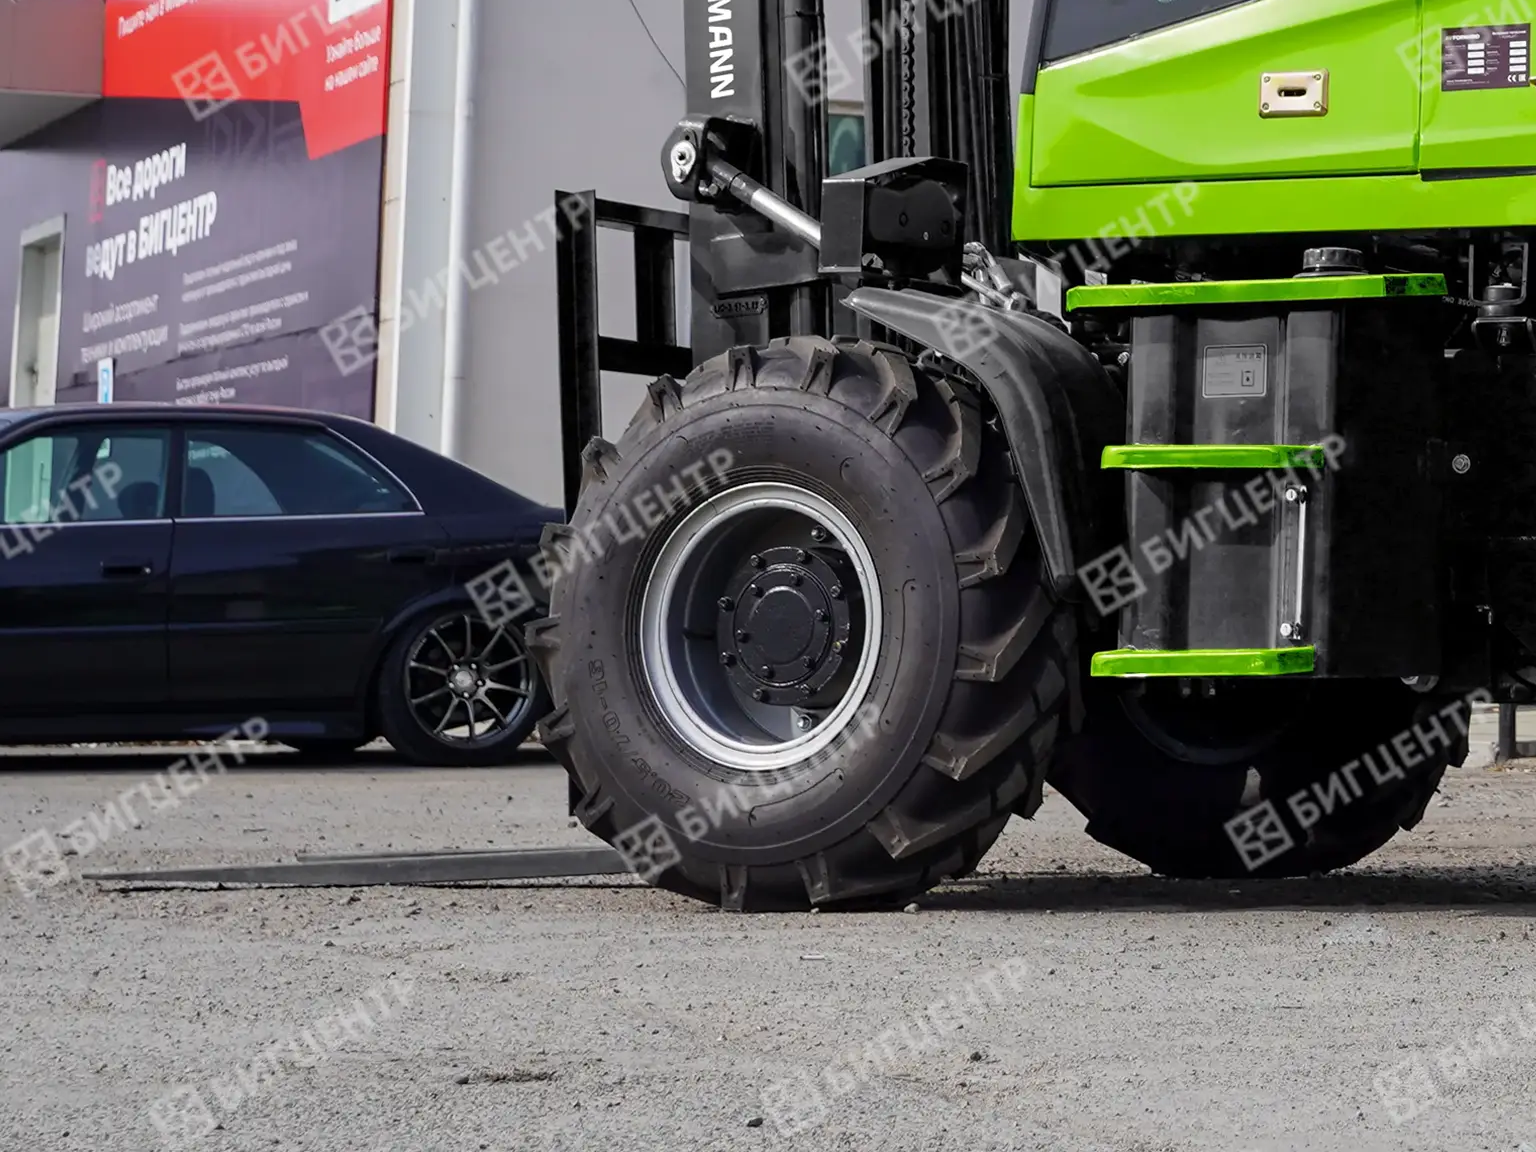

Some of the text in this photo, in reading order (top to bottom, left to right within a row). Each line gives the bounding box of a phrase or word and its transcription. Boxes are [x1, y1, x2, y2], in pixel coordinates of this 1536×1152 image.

[106, 142, 187, 207] Все дороги
[85, 232, 126, 280] ведут
[126, 229, 137, 263] в
[138, 191, 218, 260] БИГЦЕНТР
